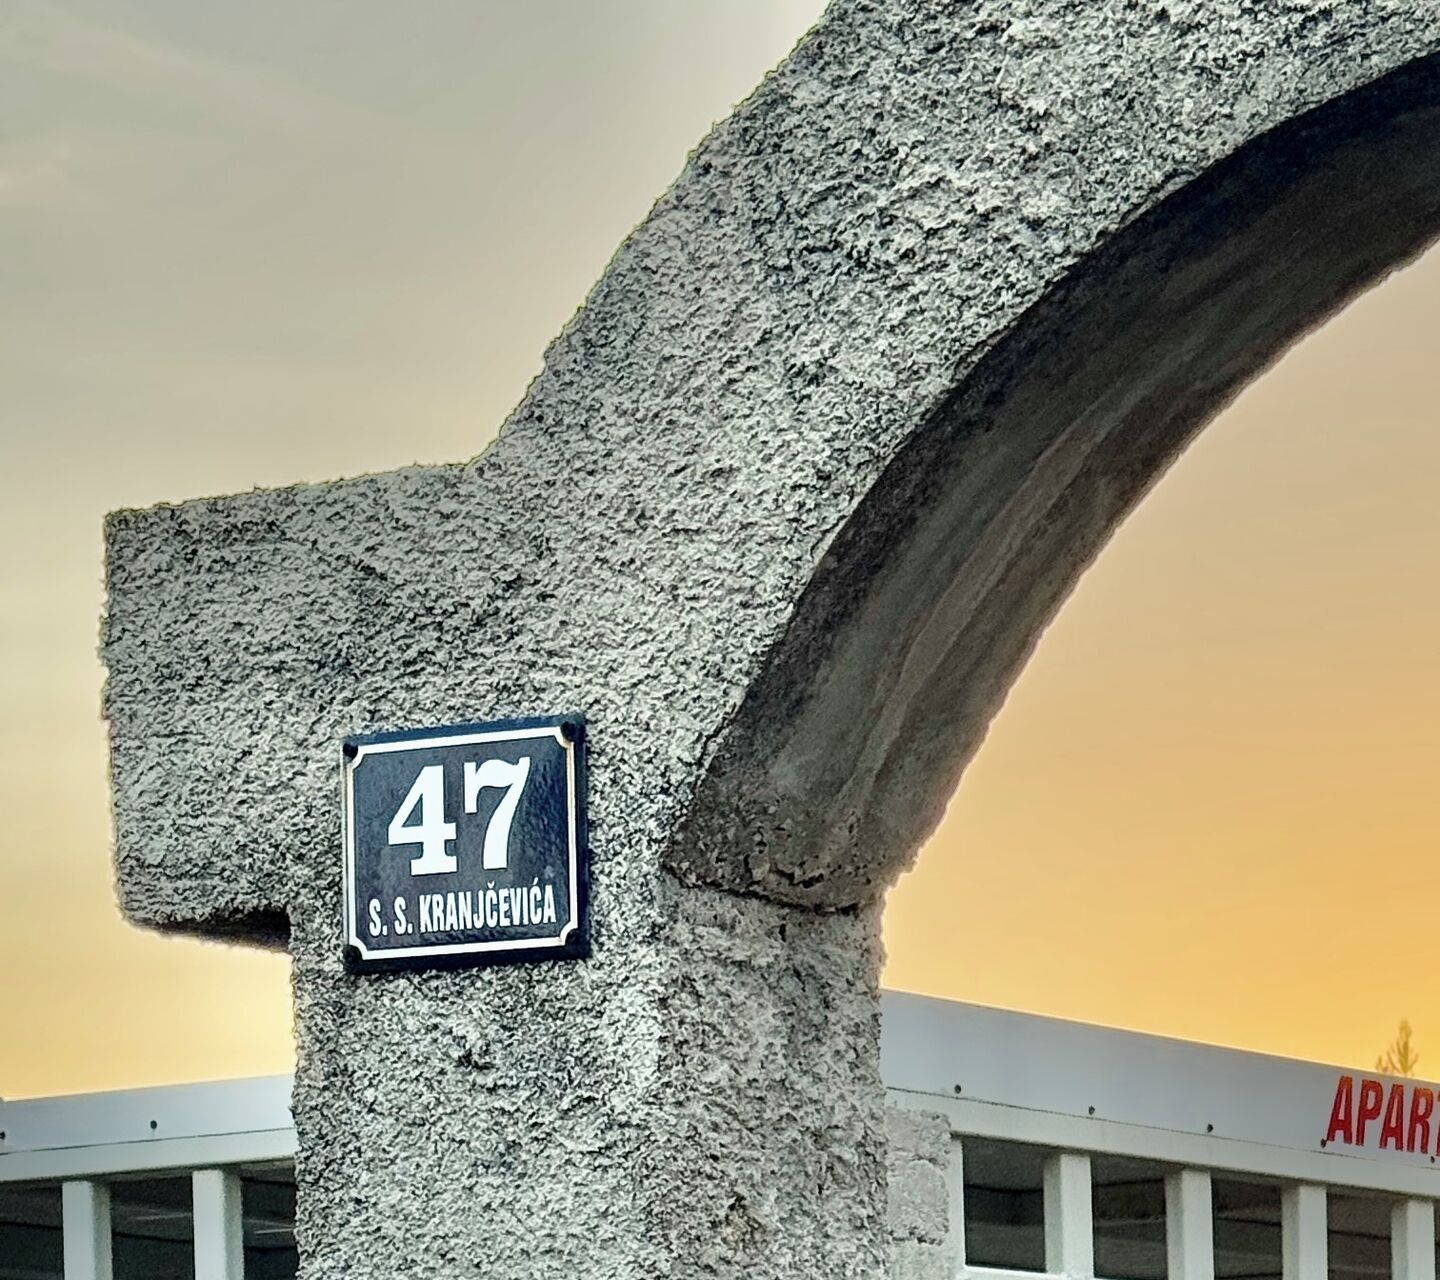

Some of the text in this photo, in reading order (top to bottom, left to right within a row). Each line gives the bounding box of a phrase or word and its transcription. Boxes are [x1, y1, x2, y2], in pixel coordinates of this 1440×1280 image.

[388, 756, 530, 876] 47
[368, 877, 556, 937] S. S. KRANJČEVIĆA
